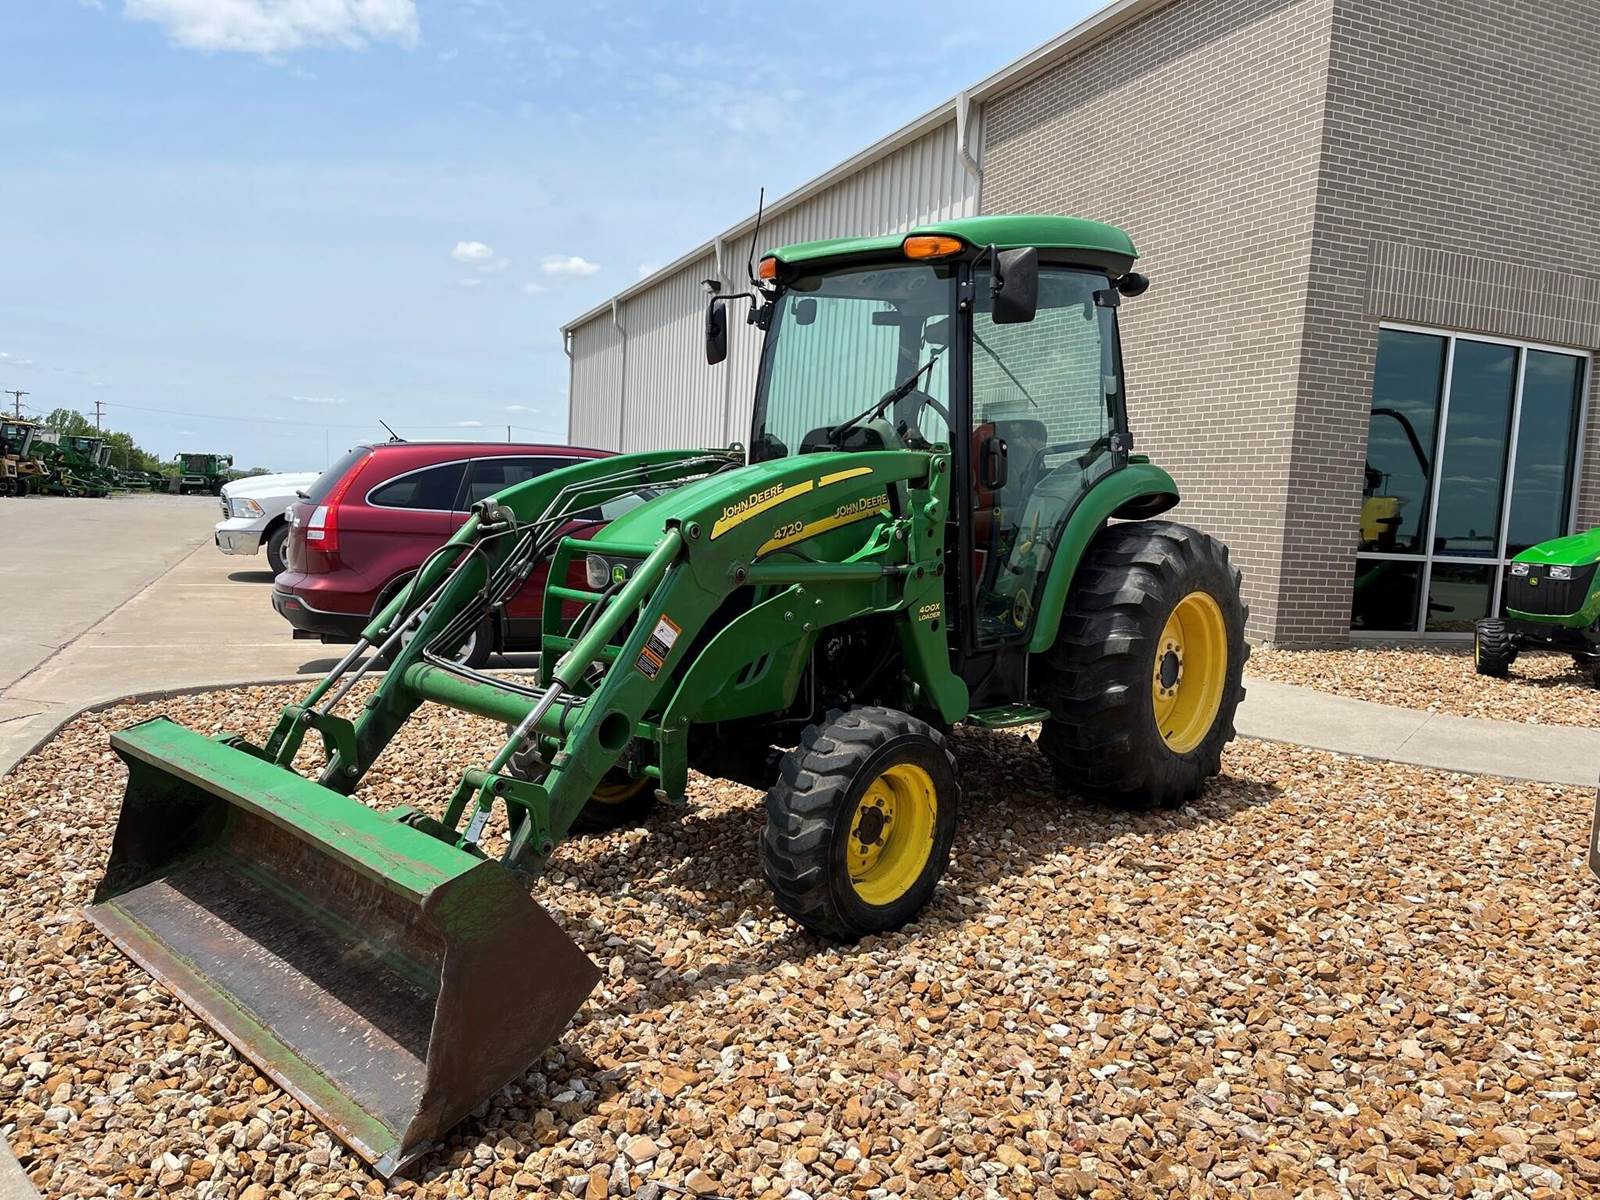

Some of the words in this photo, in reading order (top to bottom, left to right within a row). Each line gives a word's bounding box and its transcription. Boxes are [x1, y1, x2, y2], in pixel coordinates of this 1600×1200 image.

[720, 500, 749, 521] JOHN
[749, 482, 785, 507] DEERE
[832, 502, 859, 518] JOHN
[859, 494, 888, 510] DEERE
[774, 521, 803, 540] 4720
[918, 611, 941, 622] LOADER
[919, 602, 941, 613] 400X
